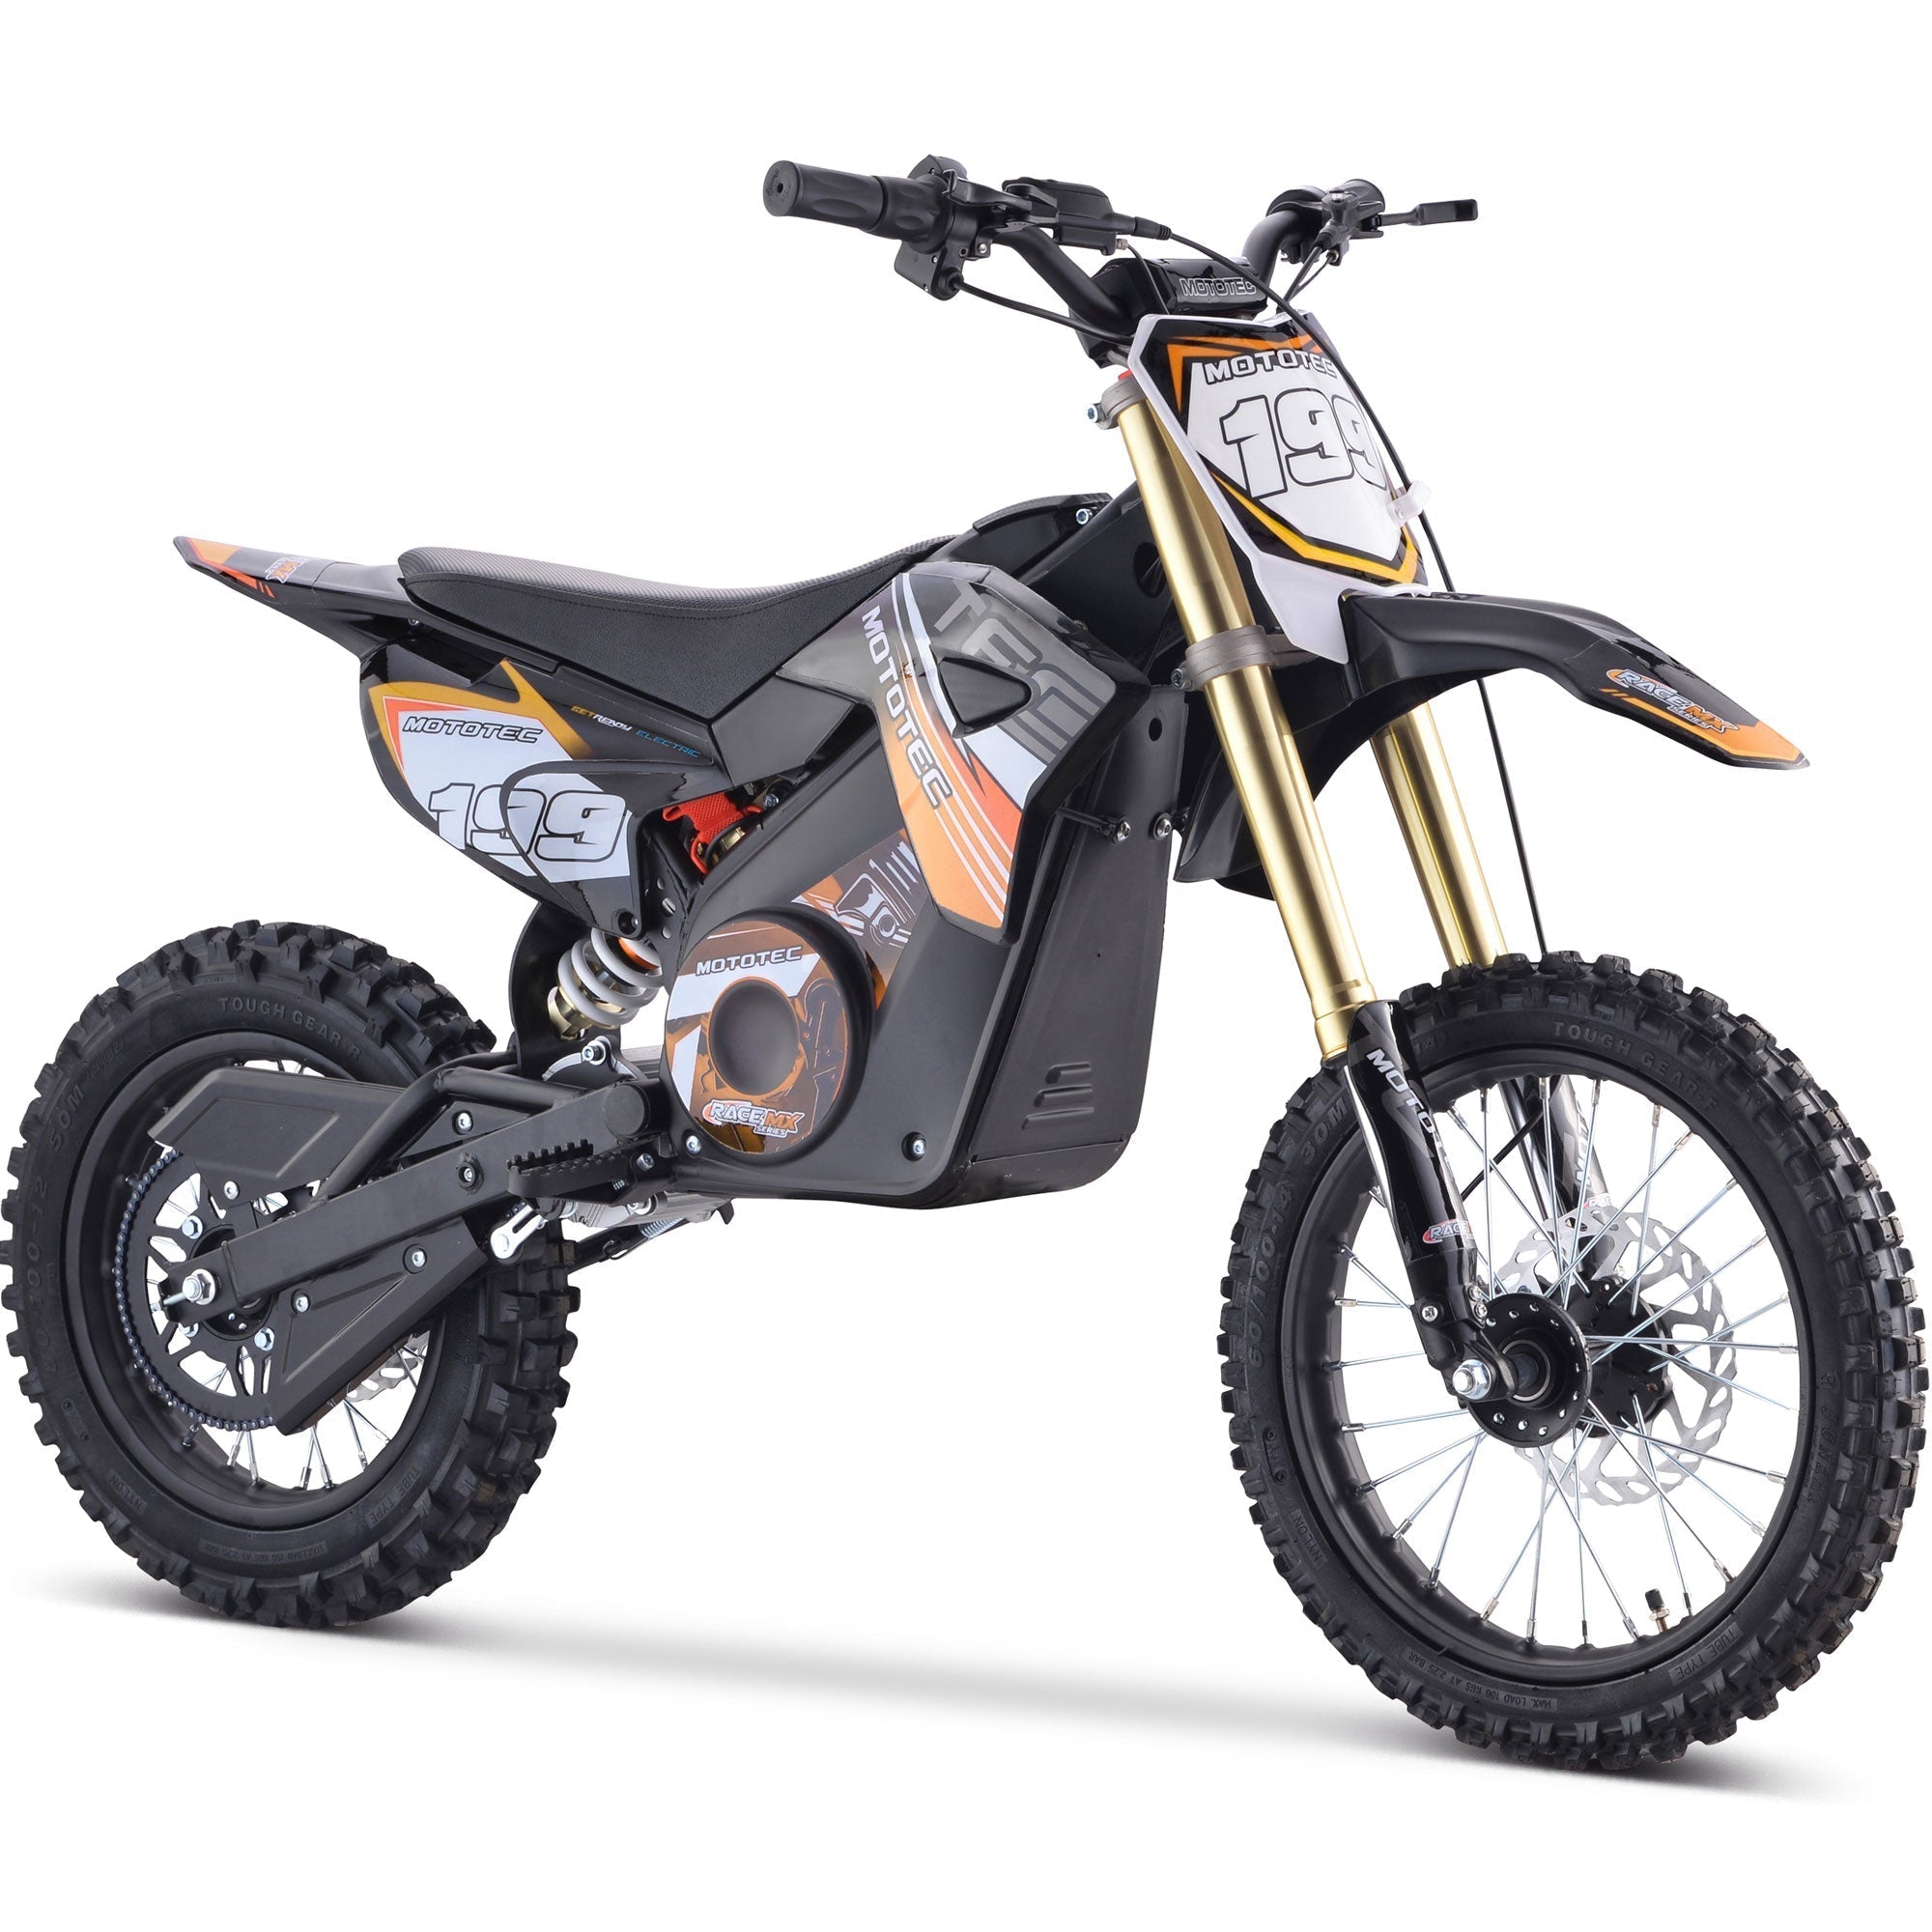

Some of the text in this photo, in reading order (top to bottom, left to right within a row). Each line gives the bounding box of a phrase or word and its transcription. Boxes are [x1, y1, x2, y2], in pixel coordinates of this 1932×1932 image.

[1179, 277, 1257, 298] MOTOTEC
[1205, 349, 1338, 384] MOTOTEC
[1219, 387, 1388, 498] 199
[862, 605, 952, 810] MOTOTEC
[402, 716, 544, 743] MOTOTEC
[635, 729, 701, 758] ELECTRIC
[428, 782, 627, 863] 199
[696, 946, 802, 977] MOTOTEC
[217, 996, 287, 1019] TOUGH
[1551, 1020, 1634, 1056] TOUGH
[49, 1084, 85, 1152] 50M
[754, 1123, 788, 1138] SERIES
[107, 1473, 143, 1510] NYLON
[367, 1464, 423, 1523] TUBE TYPE
[1293, 1515, 1323, 1563] NYLON
[1407, 1652, 1426, 1669] BAR
[1674, 1628, 1735, 1679] TUBE TYPE
[1429, 1664, 1447, 1680] 2.25
[1450, 1676, 1463, 1686] AT
[1463, 1682, 1482, 1694] KGS
[1503, 1693, 1526, 1706] LOAD
